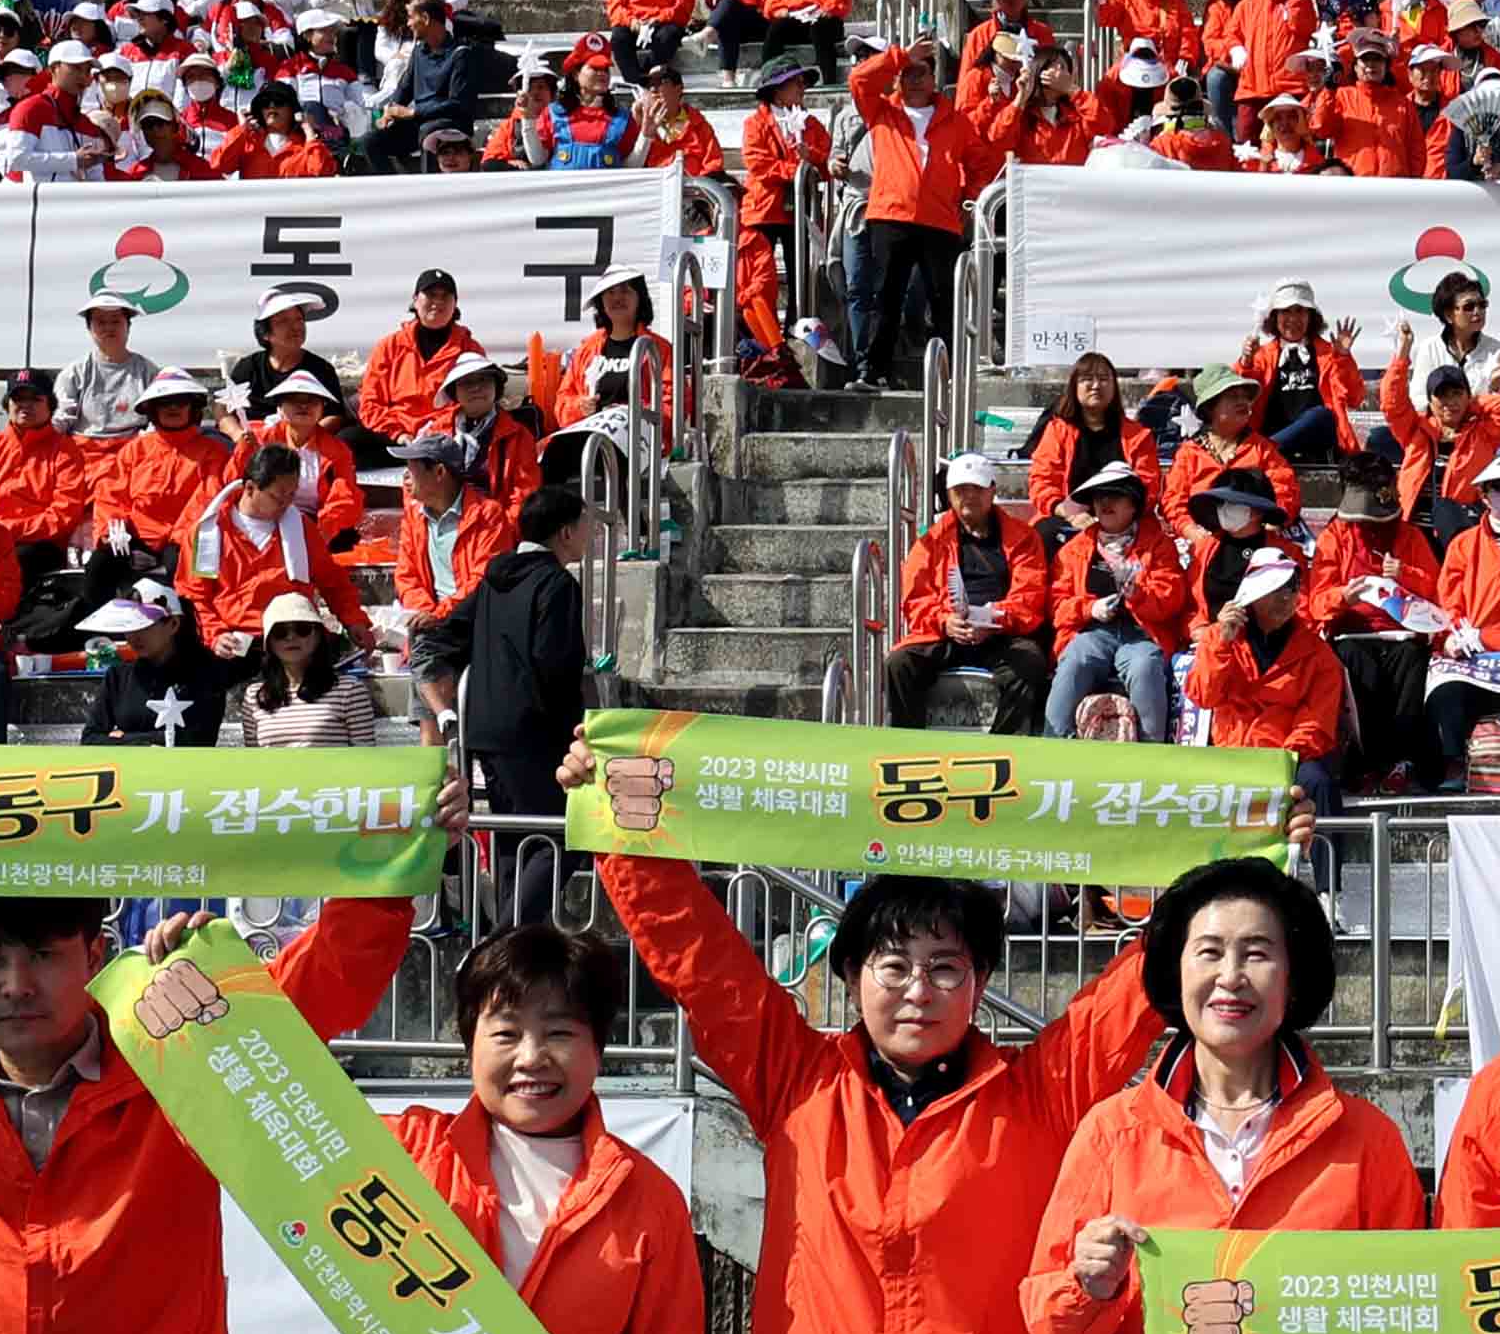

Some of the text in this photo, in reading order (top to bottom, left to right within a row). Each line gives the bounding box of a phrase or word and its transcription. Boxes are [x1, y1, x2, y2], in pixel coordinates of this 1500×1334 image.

[250, 215, 614, 323] 동구
[1032, 330, 1090, 352] 만석동
[699, 754, 849, 786] 2023 인천시민
[132, 789, 190, 835] 가
[695, 783, 848, 819] 생활 체육대회
[876, 758, 1019, 824] 동구
[1027, 780, 1080, 825] 가
[895, 842, 1092, 876] 인천광역시동구체육회
[206, 1043, 325, 1184] 생활 체육대회
[235, 1028, 352, 1165] 2023 인천시민
[326, 1176, 473, 1308] 동구
[1278, 1271, 1439, 1301] 2023 인천시민
[1277, 1303, 1440, 1334] 생활 체육대회
